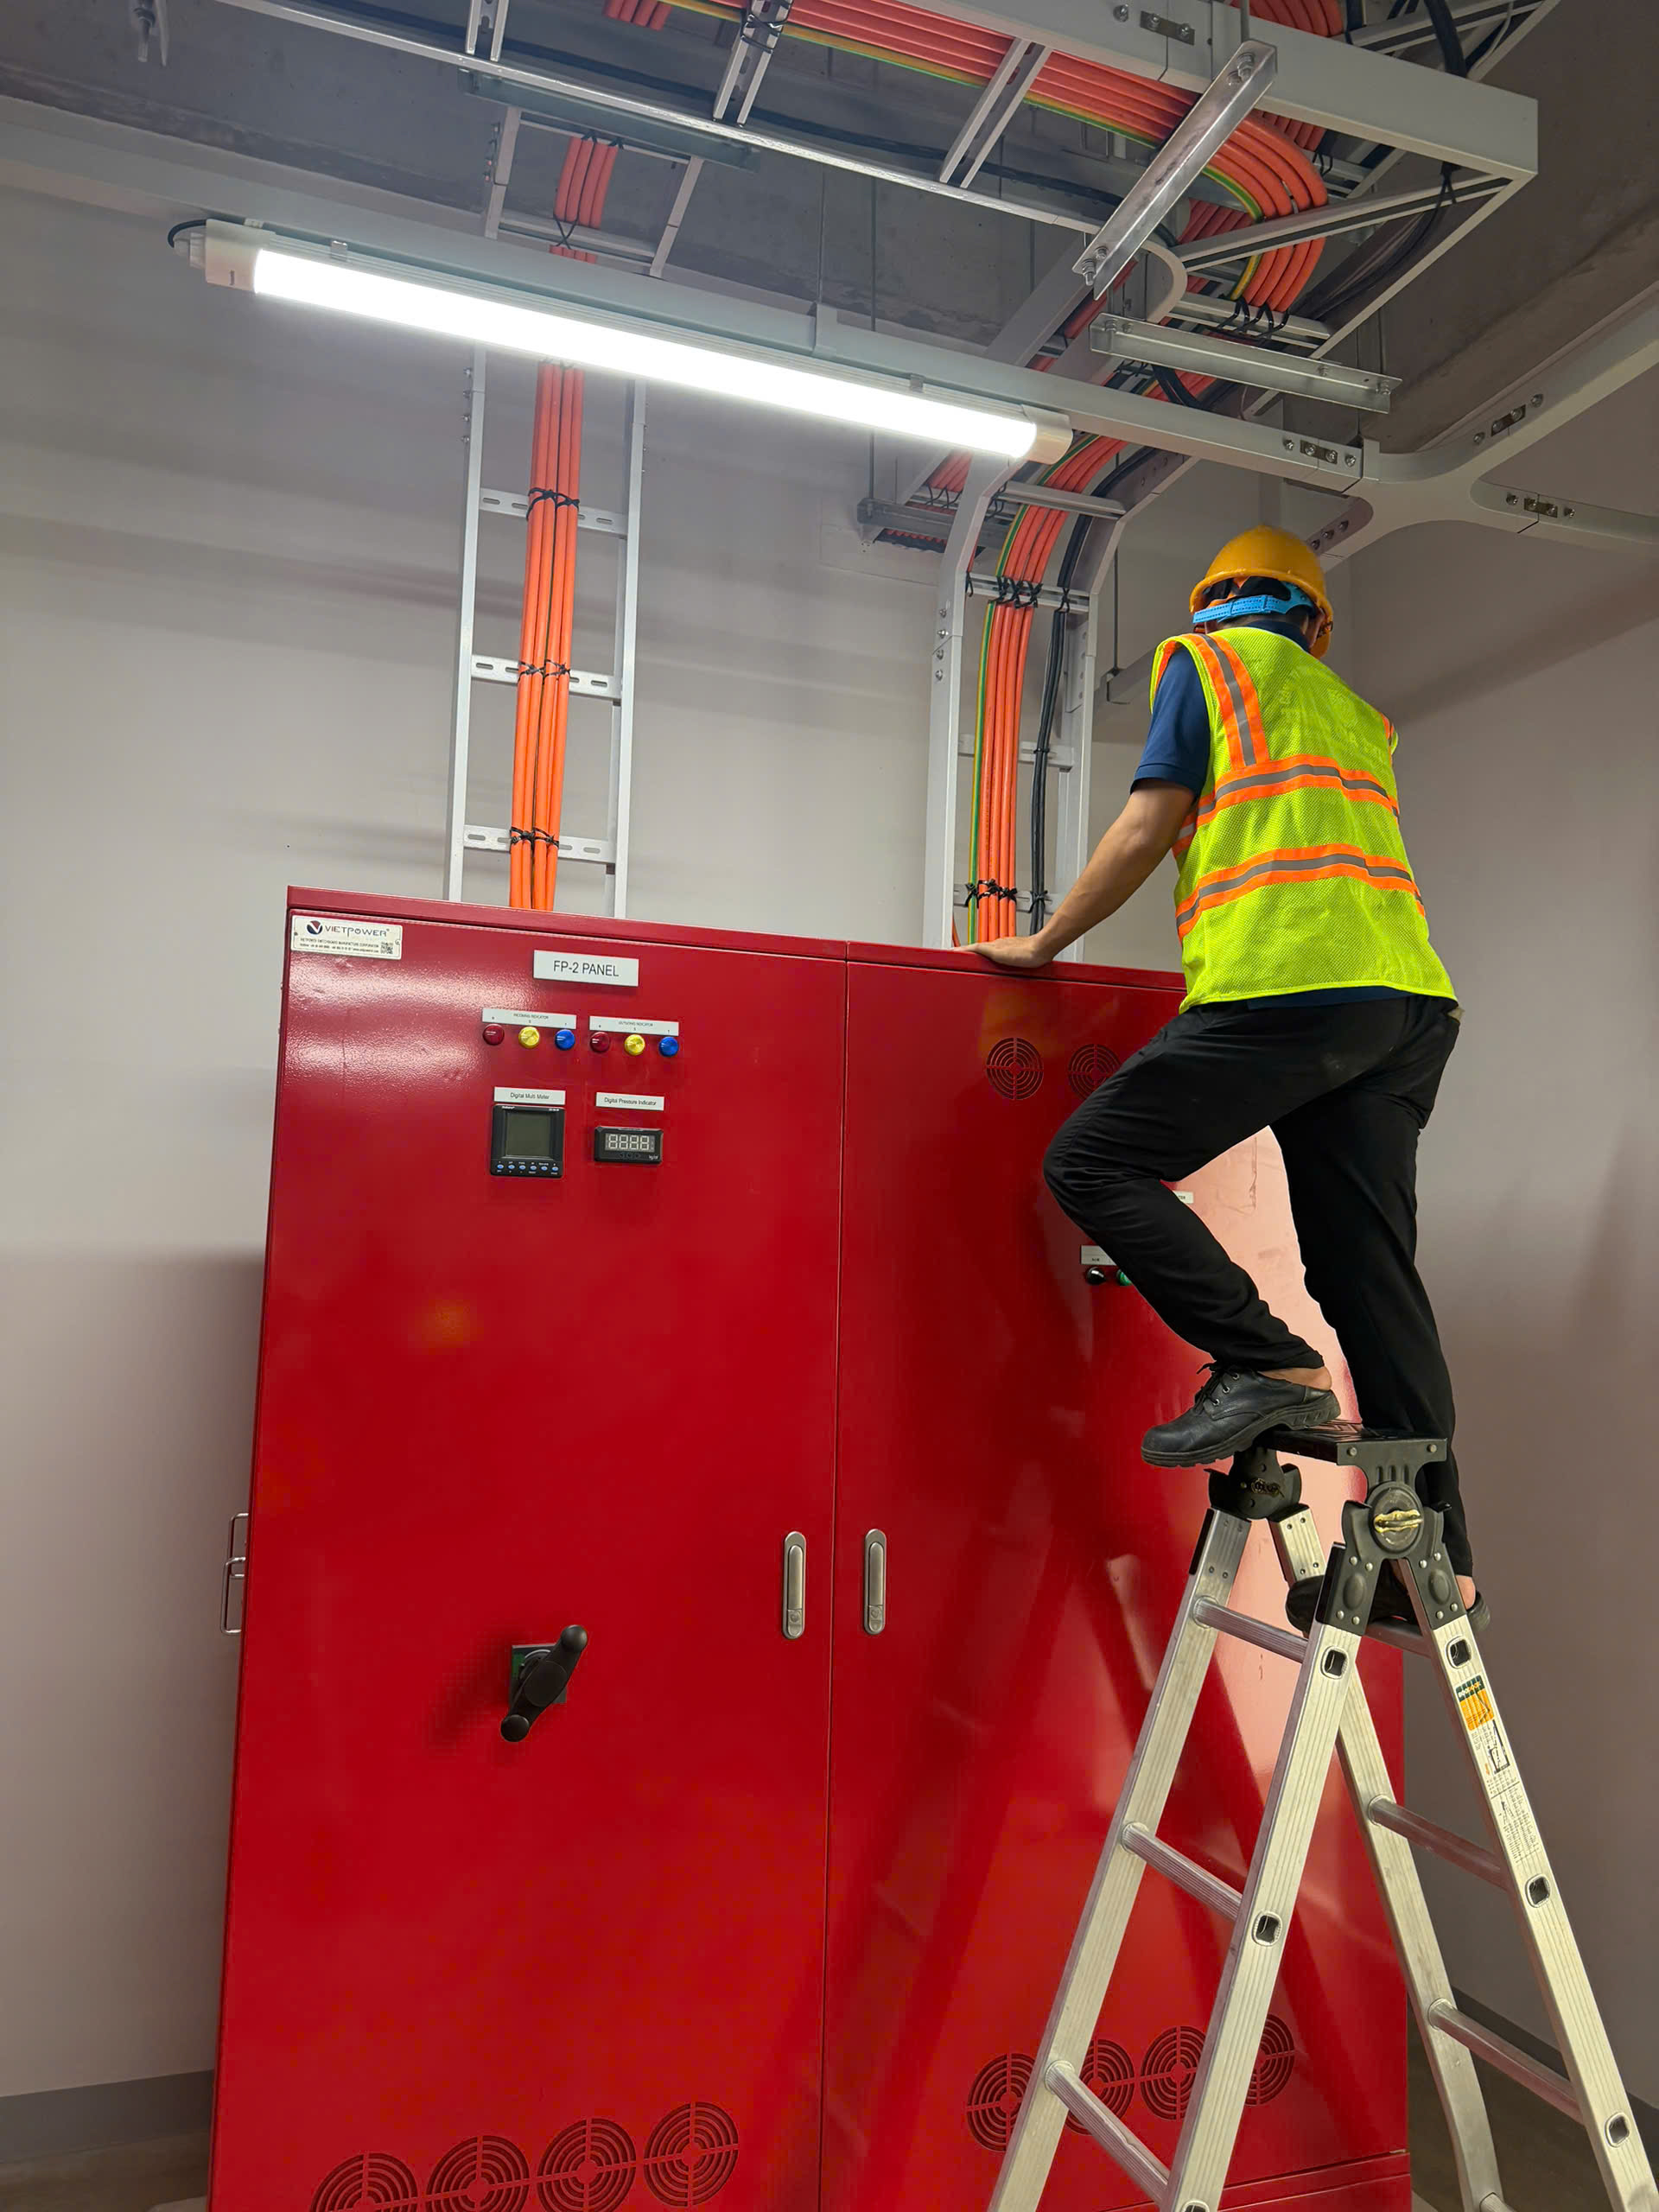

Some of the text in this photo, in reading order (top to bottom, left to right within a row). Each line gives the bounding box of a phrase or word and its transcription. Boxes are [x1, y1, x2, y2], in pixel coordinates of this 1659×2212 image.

[325, 925, 386, 937] VIETPOWER
[553, 960, 620, 977] FP-2 PANEL
